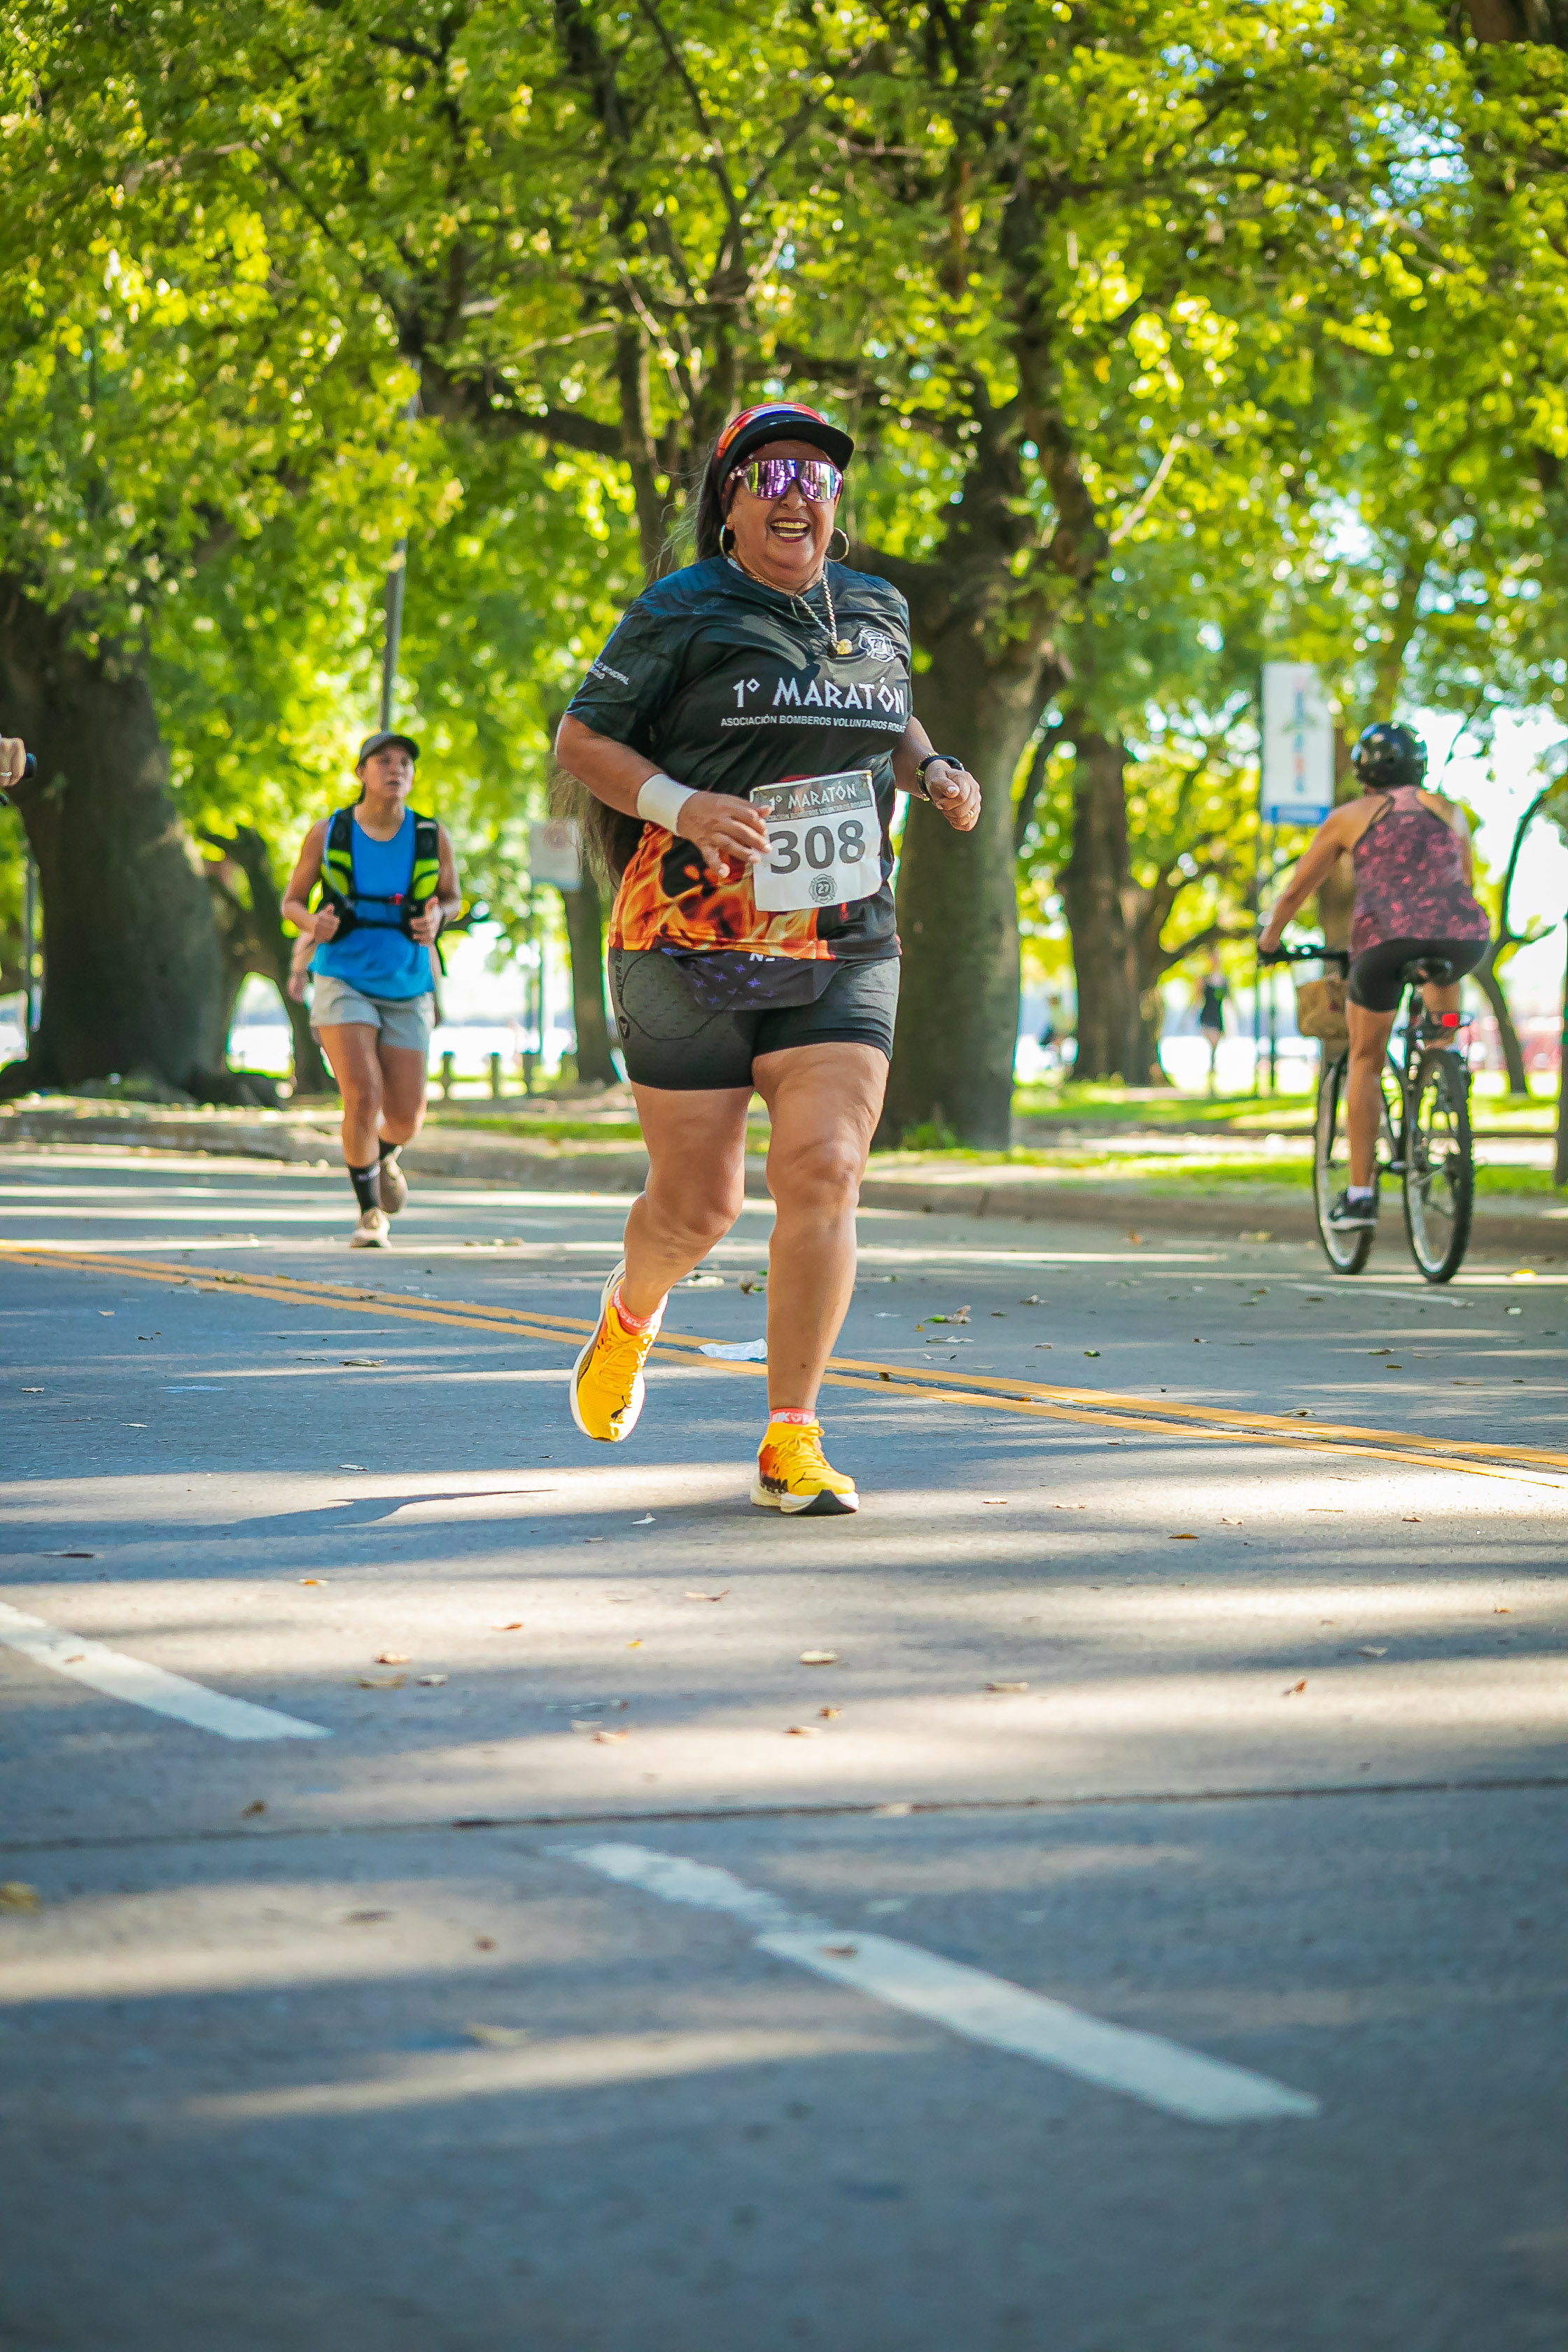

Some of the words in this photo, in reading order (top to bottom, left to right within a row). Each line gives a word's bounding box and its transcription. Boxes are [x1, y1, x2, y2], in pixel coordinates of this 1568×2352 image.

[772, 676, 905, 715] MARATÓN
[721, 713, 778, 727] ASOCIACIÓN
[779, 715, 832, 726] BOMBEROS
[833, 718, 888, 730] VOLUNTARIOS
[788, 780, 858, 809] MARATÓN
[769, 820, 866, 874] 308
[818, 883, 830, 895] 27
